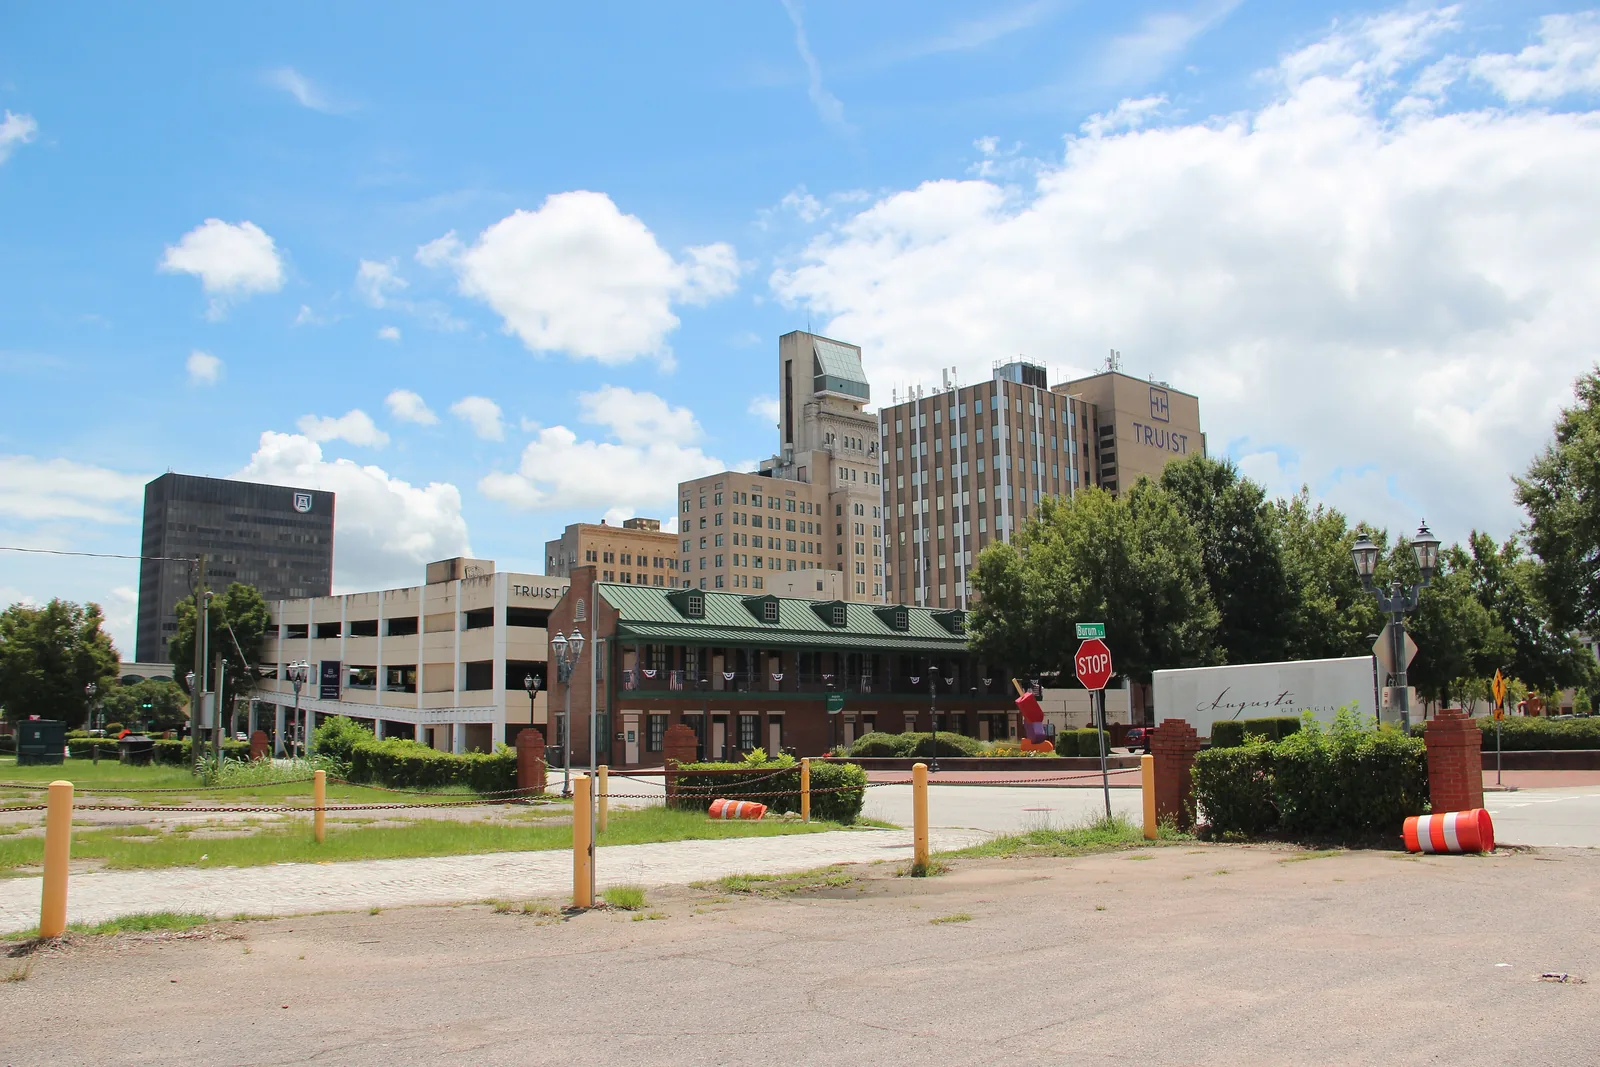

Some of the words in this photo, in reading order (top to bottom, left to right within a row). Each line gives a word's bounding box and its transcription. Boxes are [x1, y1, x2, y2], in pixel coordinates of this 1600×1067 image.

[1133, 422, 1187, 454] TRUIST
[513, 585, 559, 599] TRUIST
[1078, 653, 1108, 675] STOP
[1196, 686, 1295, 720] Augusta
